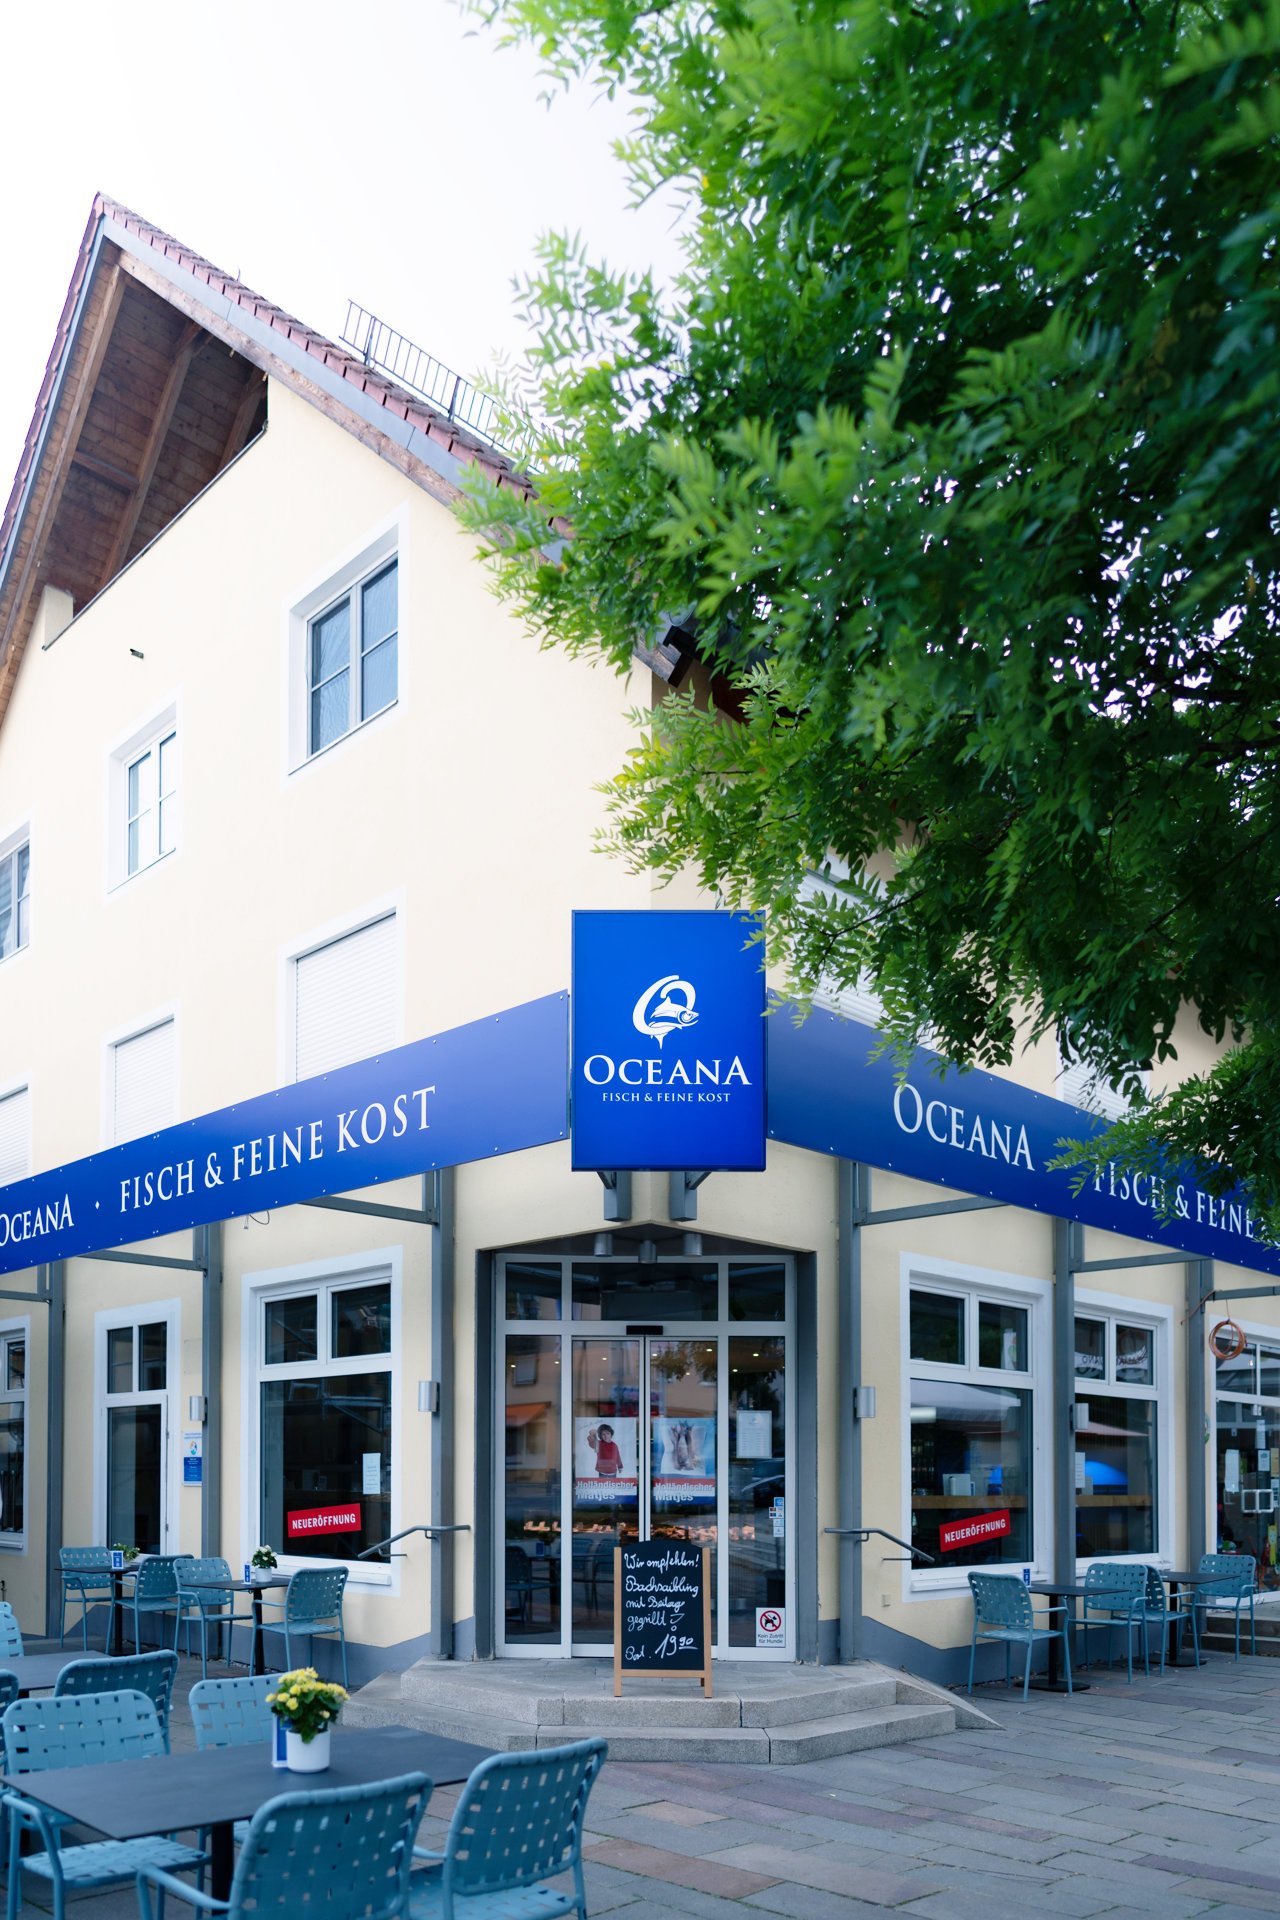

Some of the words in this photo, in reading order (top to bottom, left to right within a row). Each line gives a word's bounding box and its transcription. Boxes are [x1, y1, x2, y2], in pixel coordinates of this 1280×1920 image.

[583, 1054, 753, 1086] OCEANA
[602, 1092, 640, 1102] FISCH
[644, 1092, 653, 1102] &
[657, 1092, 694, 1102] FEINE
[698, 1092, 731, 1103] KOST
[120, 1158, 195, 1213] FISCH
[204, 1152, 224, 1188] &
[232, 1119, 324, 1182] FEINE
[336, 1085, 436, 1153] KOST
[893, 1083, 1036, 1172] OCEANA
[1174, 1184, 1191, 1220] &
[577, 1481, 634, 1490] Holländischer
[655, 1482, 713, 1492] Holländischer
[292, 1513, 356, 1529] NEUERÖFFNUNG
[944, 1518, 1006, 1543] NEUERÖFFNUNG
[624, 1553, 644, 1569] Wir
[625, 1575, 699, 1598] Bachsaibling
[625, 1596, 646, 1608] mit
